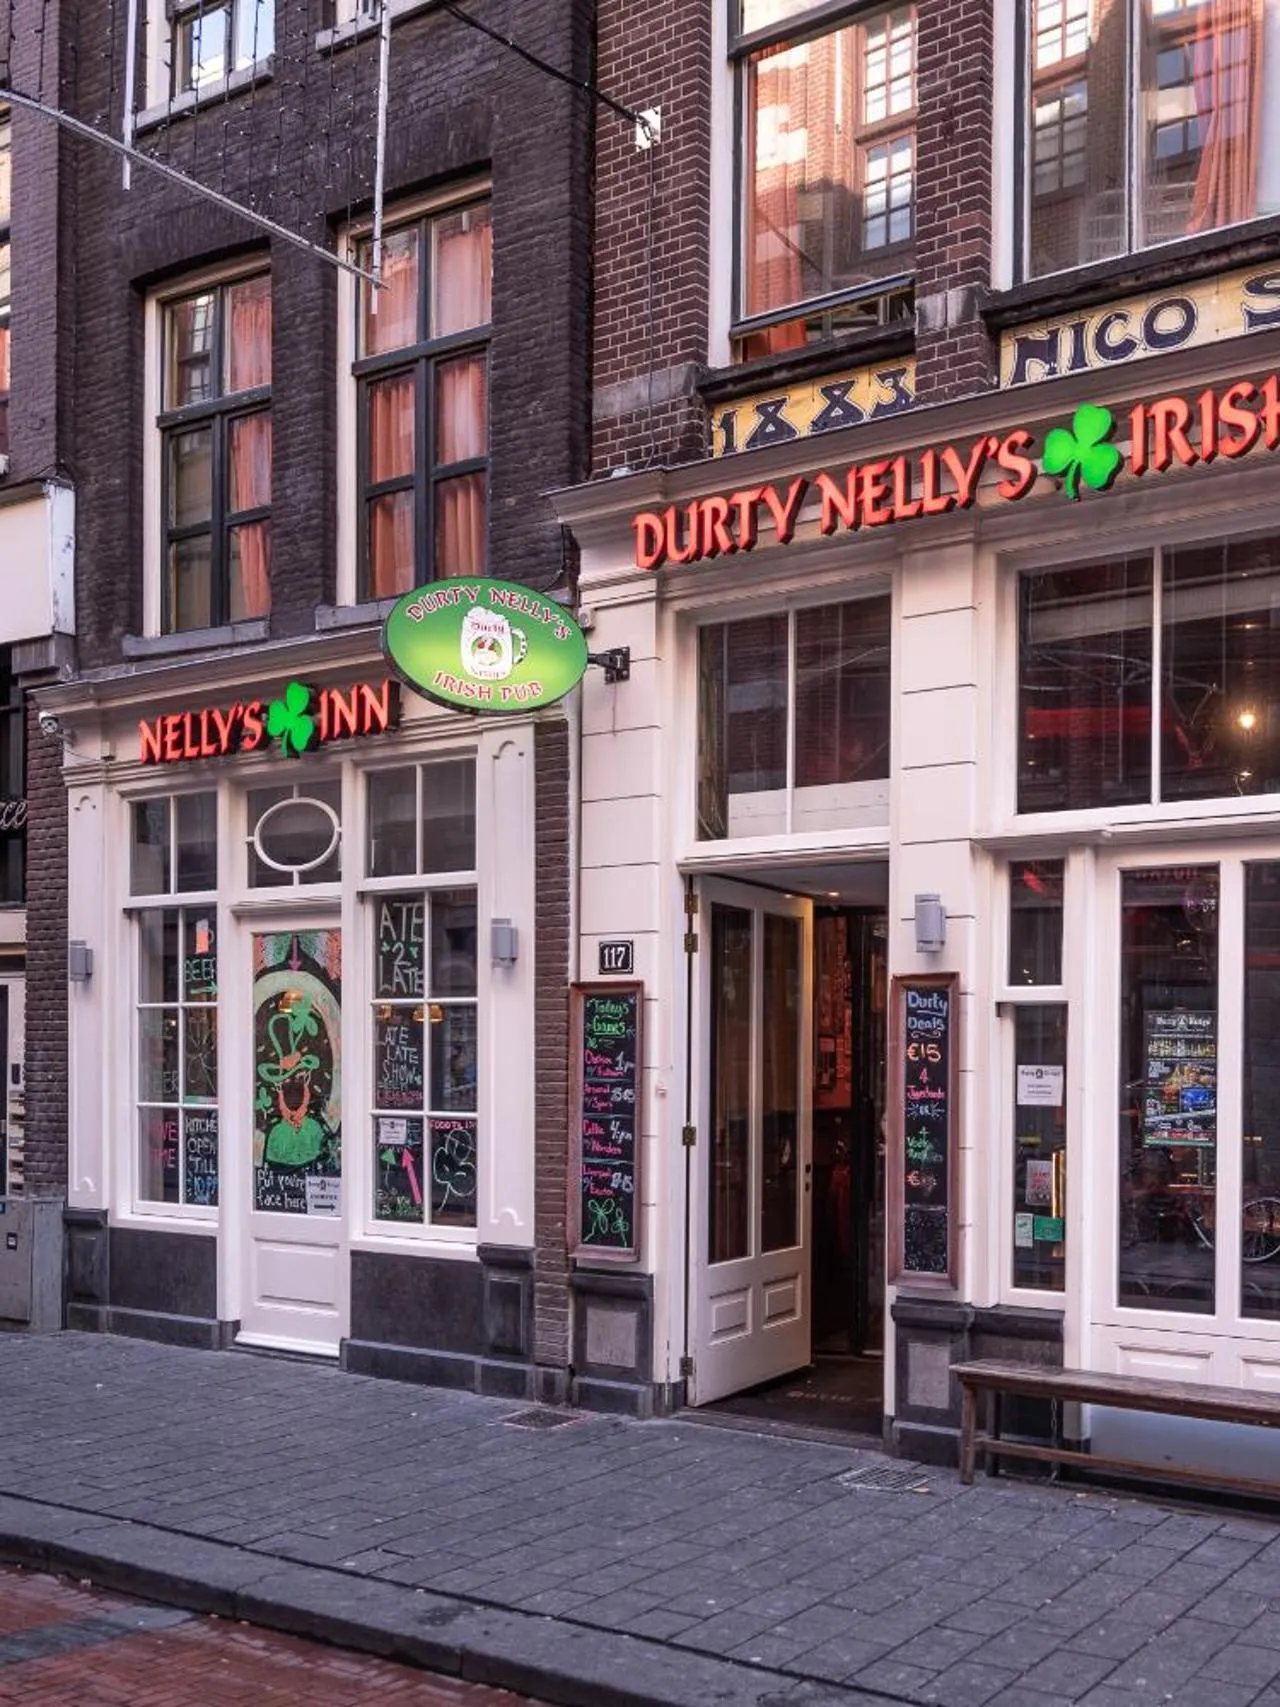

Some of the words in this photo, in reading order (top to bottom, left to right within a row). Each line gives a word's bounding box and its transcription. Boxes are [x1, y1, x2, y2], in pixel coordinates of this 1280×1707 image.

[1006, 297, 1199, 390] NICO
[719, 367, 917, 455] 1883
[632, 477, 808, 571] DURTY
[816, 429, 1038, 536] NELLY'S
[406, 585, 481, 622] DURTY
[489, 587, 572, 640] NELLY'S
[432, 671, 494, 700] IRISH
[500, 682, 543, 704] PUB
[138, 699, 264, 764] NELLY'S
[319, 679, 392, 741] INN
[391, 941, 411, 965] 2
[603, 947, 626, 969] 117
[379, 955, 424, 994] LATE
[907, 991, 948, 1016] Durty
[907, 1017, 945, 1031] Deals
[907, 1043, 941, 1062] €15
